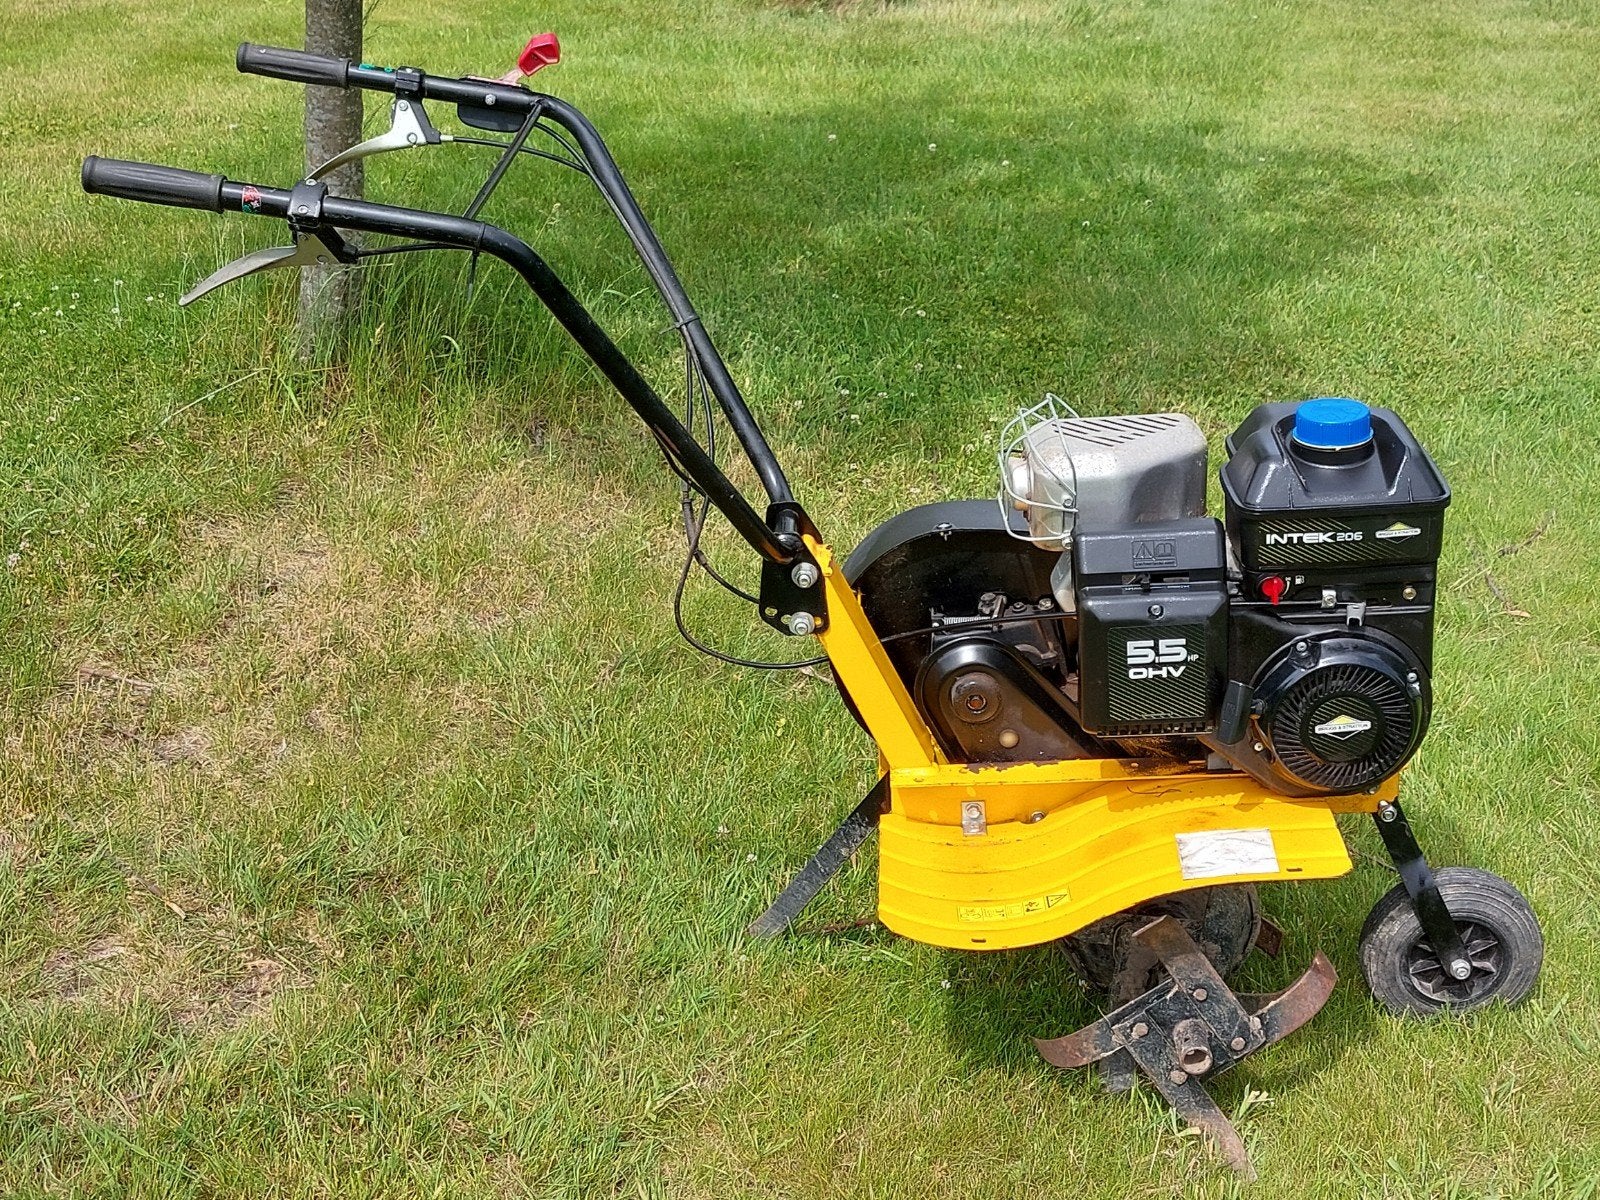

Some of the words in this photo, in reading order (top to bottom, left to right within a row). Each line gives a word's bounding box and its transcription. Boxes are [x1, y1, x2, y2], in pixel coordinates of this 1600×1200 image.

[1266, 532, 1336, 545] INTEK
[1336, 531, 1363, 542] 206
[1127, 639, 1188, 664] 5.5
[1188, 654, 1199, 662] HP
[1128, 666, 1186, 680] OHV
